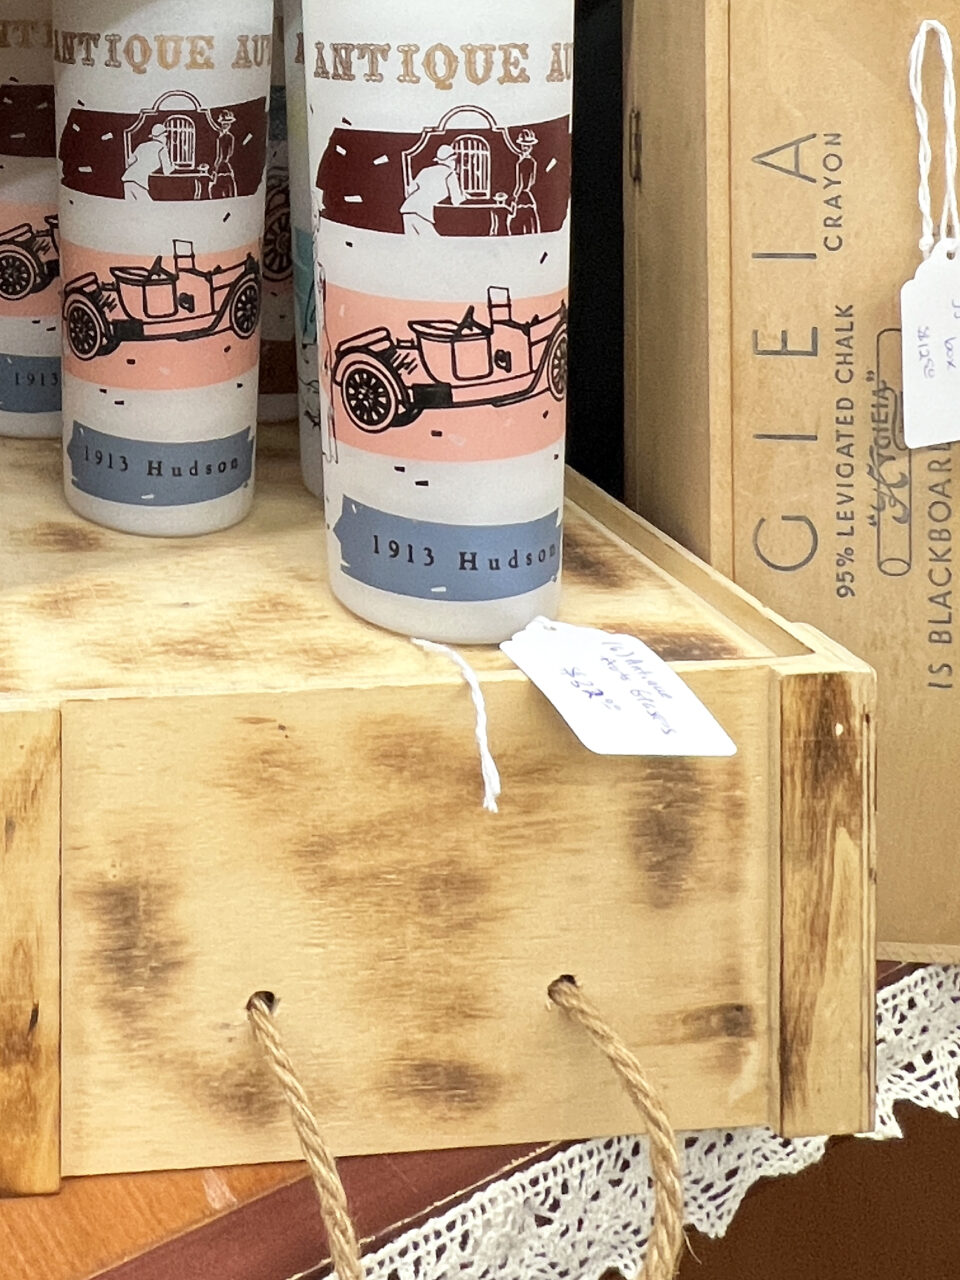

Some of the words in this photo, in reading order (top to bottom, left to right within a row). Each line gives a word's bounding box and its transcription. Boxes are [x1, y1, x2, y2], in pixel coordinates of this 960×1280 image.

[313, 40, 531, 90] ANTIQUE
[823, 132, 843, 252] CRAYON
[834, 304, 855, 384] CHALK
[15, 372, 59, 387] 1913
[83, 445, 130, 472] 1913
[146, 456, 239, 478] Hudson
[835, 396, 856, 537] LEVIGATED
[373, 534, 436, 567] 1913
[458, 543, 556, 571] Hudson
[836, 545, 856, 599] 95%
[928, 662, 954, 689] IS
